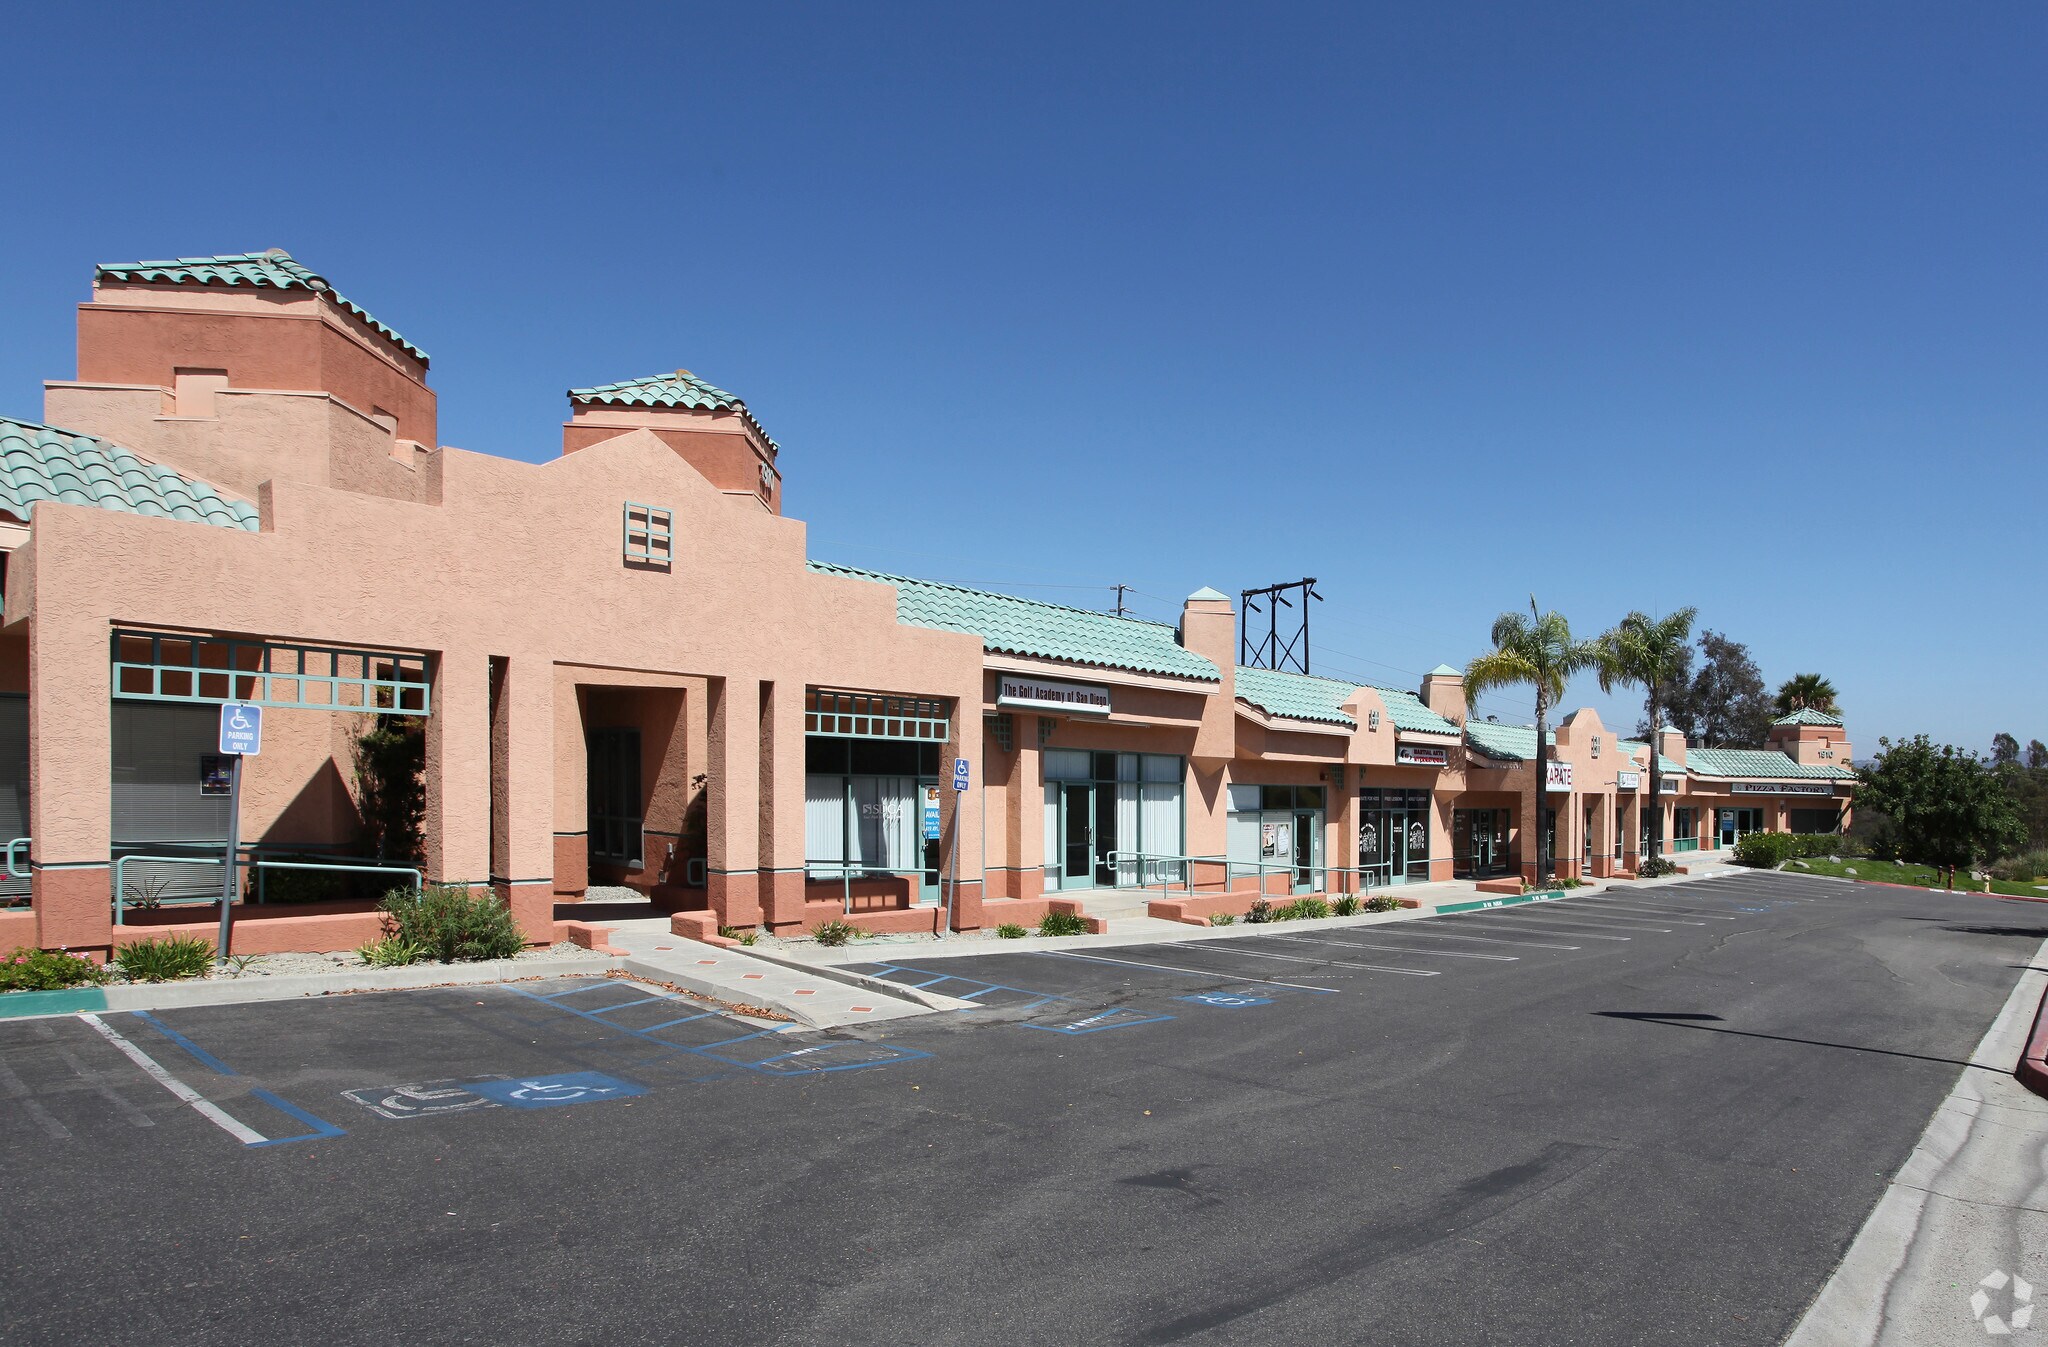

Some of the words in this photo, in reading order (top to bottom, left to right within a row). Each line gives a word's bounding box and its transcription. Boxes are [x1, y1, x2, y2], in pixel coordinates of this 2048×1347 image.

[1003, 683, 1017, 697] The
[1019, 685, 1033, 698] Golf
[1035, 687, 1065, 703] Academy
[1067, 691, 1074, 702] of
[1076, 691, 1088, 704] San
[1089, 693, 1107, 707] Diego
[227, 732, 253, 740] PARKING
[232, 742, 249, 751] ONLY
[1744, 784, 1776, 792] PIZZA
[1779, 784, 1825, 793] FACTORY
